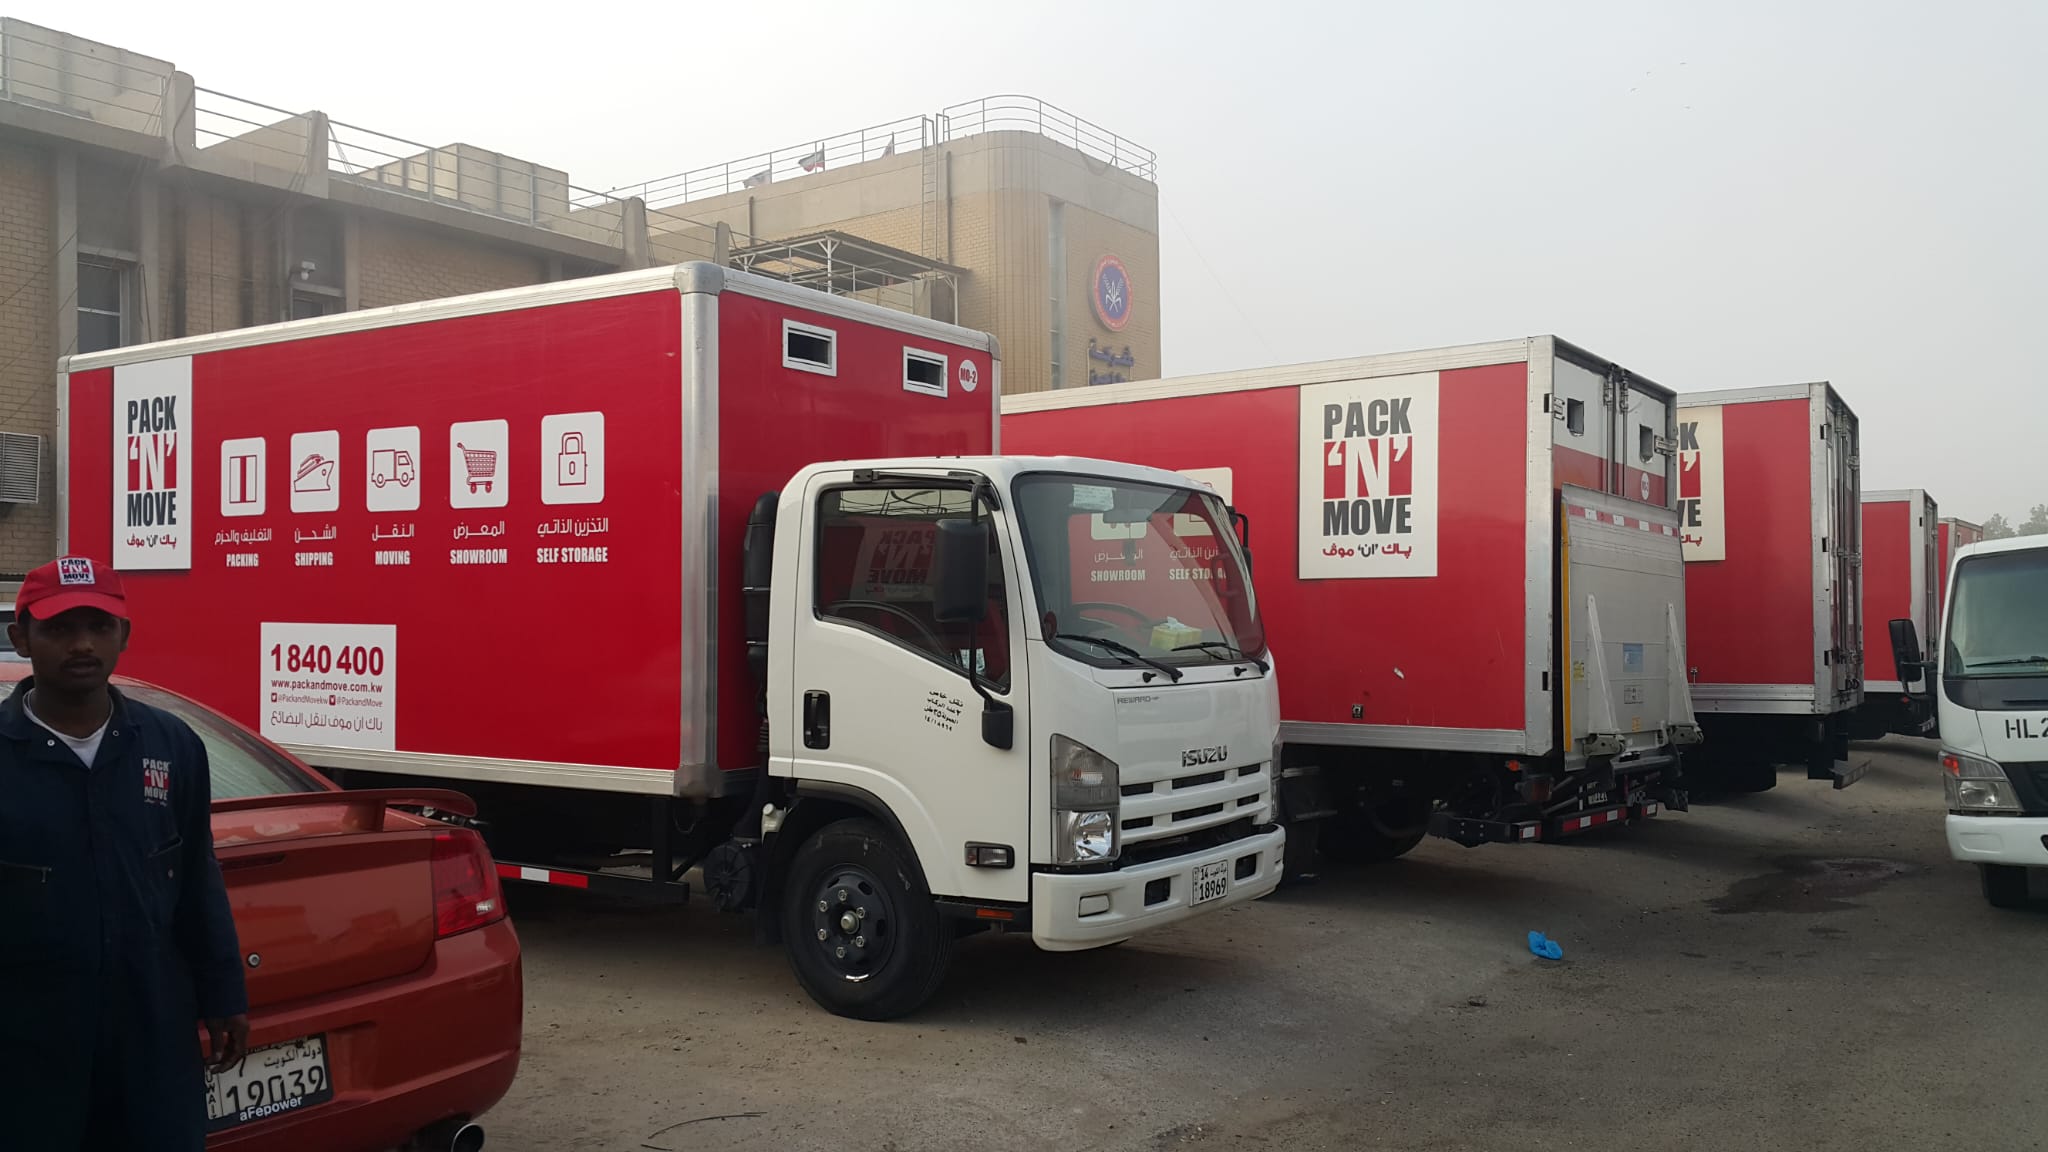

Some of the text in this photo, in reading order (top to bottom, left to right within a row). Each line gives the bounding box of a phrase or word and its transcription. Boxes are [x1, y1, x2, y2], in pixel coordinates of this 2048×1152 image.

[127, 395, 177, 434] PACK
[1323, 397, 1412, 440] PACK
[127, 491, 177, 527] MOVE
[1323, 497, 1412, 536] MOVE
[294, 523, 337, 543] الشحن
[372, 523, 415, 542] النقل
[453, 520, 505, 540] المعرض
[537, 517, 609, 538] التخزين الذاتي
[241, 528, 272, 545] التغليف
[226, 553, 259, 567] PACKING
[295, 552, 334, 566] SHIPPING
[375, 550, 411, 565] MOVING
[450, 549, 508, 564] SHOWROOM
[537, 547, 608, 564] SELF STORAGE
[1091, 569, 1146, 582] SHOWROOM
[1169, 568, 1191, 581] SELF
[271, 679, 383, 693] www.packandmove.com.kw
[270, 710, 304, 727] البضائع
[305, 712, 327, 728] لنقل
[1181, 744, 1228, 767] ISUZU
[142, 758, 170, 771] PACK
[144, 786, 168, 801] MOVE
[1200, 867, 1209, 880] 14
[1199, 877, 1227, 901] 18969
[264, 1048, 299, 1069] الكويت
[303, 1044, 321, 1060] دولة
[226, 1066, 324, 1110] 19039
[239, 1097, 303, 1121] aFepower
